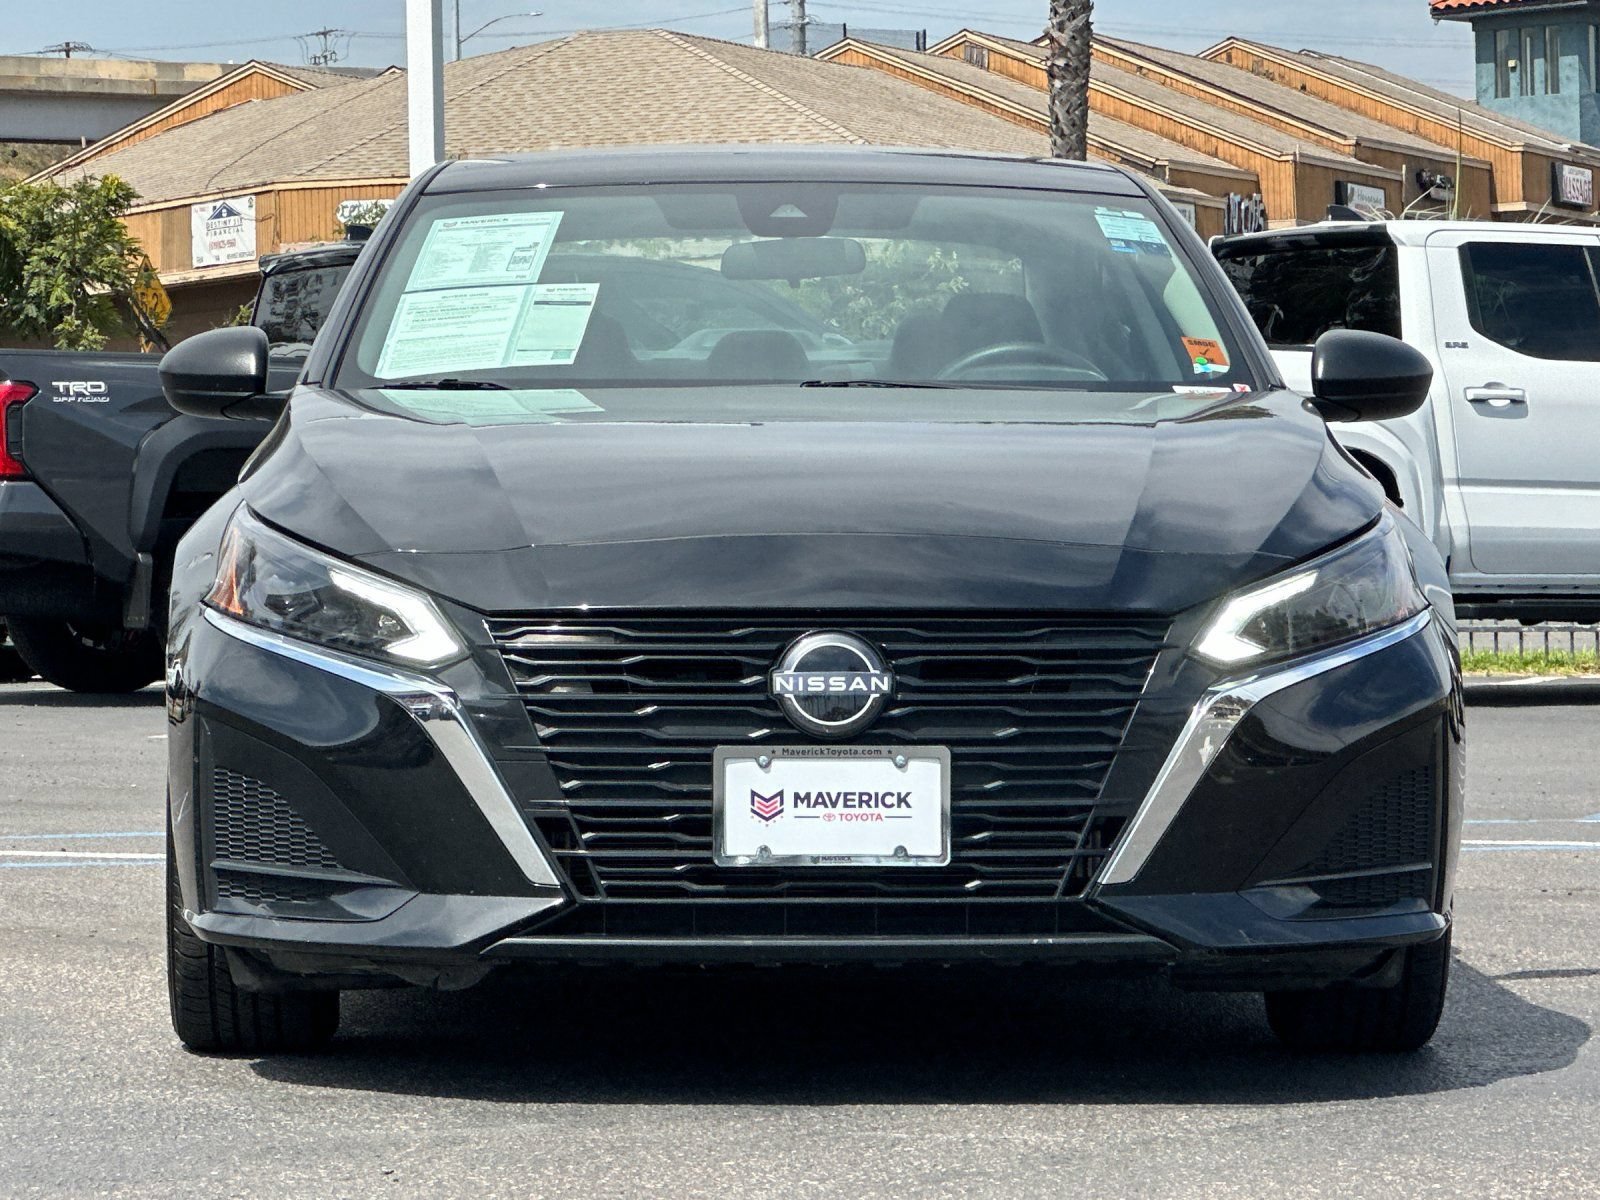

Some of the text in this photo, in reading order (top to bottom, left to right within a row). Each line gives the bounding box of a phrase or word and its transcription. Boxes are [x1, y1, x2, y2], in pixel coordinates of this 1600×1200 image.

[1563, 175, 1592, 203] MASSAGE
[52, 381, 106, 395] TRD
[775, 676, 889, 692] NISSAN
[781, 747, 882, 758] MaverickToyota.com
[793, 791, 912, 809] MAVERICK
[839, 813, 883, 822] TOYOTA
